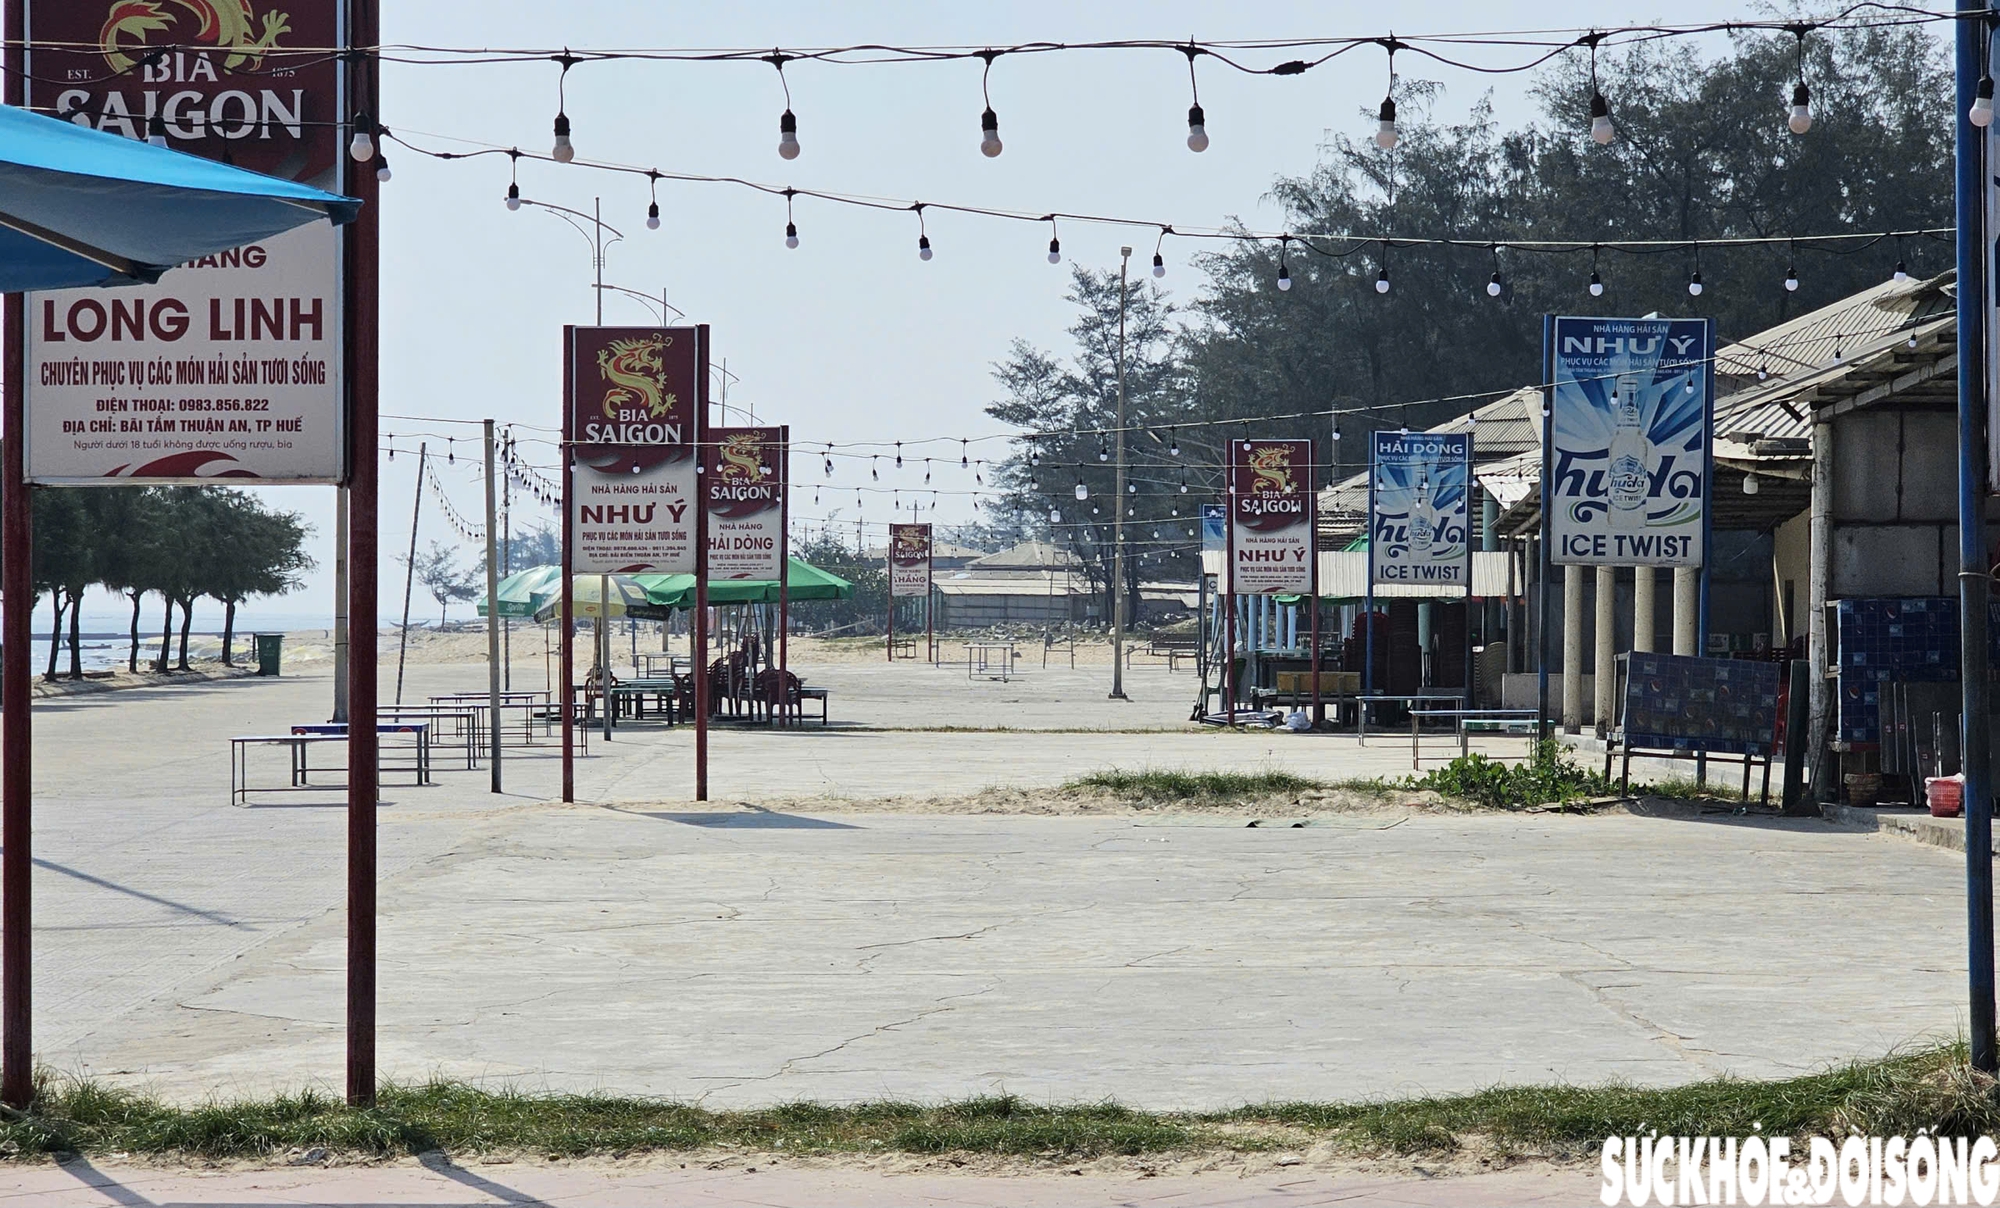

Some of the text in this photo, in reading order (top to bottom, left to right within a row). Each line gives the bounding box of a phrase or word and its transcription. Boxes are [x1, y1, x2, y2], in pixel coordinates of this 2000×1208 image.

[143, 52, 218, 82] BIA
[68, 70, 92, 80] EST.
[57, 90, 304, 140] SAIGON
[44, 298, 322, 342] LONG LINH
[1593, 324, 1668, 333] NHÀ HÀNG HẢI SẢN
[1564, 335, 1696, 354] NHƯ Ý
[1561, 357, 1580, 367] PHỤC
[1582, 357, 1592, 367] VỤ
[1594, 356, 1607, 366] CÁC
[41, 352, 326, 390] CHUYÊN PHỤC VỤ CÁC MÓN HẢI SẢN TƯƠI SỐNG
[96, 397, 269, 414] ĐIỆN THOẠI: 0983.856.822
[620, 408, 649, 422] BIA
[62, 416, 303, 435] ĐỊA CHỈ: BÃI TẮM THUẬN AN, TP HUẾ
[586, 423, 682, 443] SAIGON
[74, 439, 292, 451] Người dưới 18 tuổi không được uống rượu, bia
[1380, 440, 1463, 454] HẢI DÒNG
[1555, 447, 1700, 498] huda
[592, 482, 678, 494] NHÀ HÀNG HẢI SẢN
[710, 486, 770, 499] SAIGON
[1262, 491, 1280, 499] BIA
[581, 498, 688, 524] NHƯ Ý
[1242, 499, 1301, 512] SAIGON
[739, 522, 763, 530] HÀNG
[708, 532, 774, 550] HẢI DÒNG
[1562, 534, 1692, 557] ICE TWIST
[1239, 546, 1306, 562] NHƯ Ý
[1380, 565, 1460, 579] ICE TWIST
[506, 603, 525, 612] Sprite
